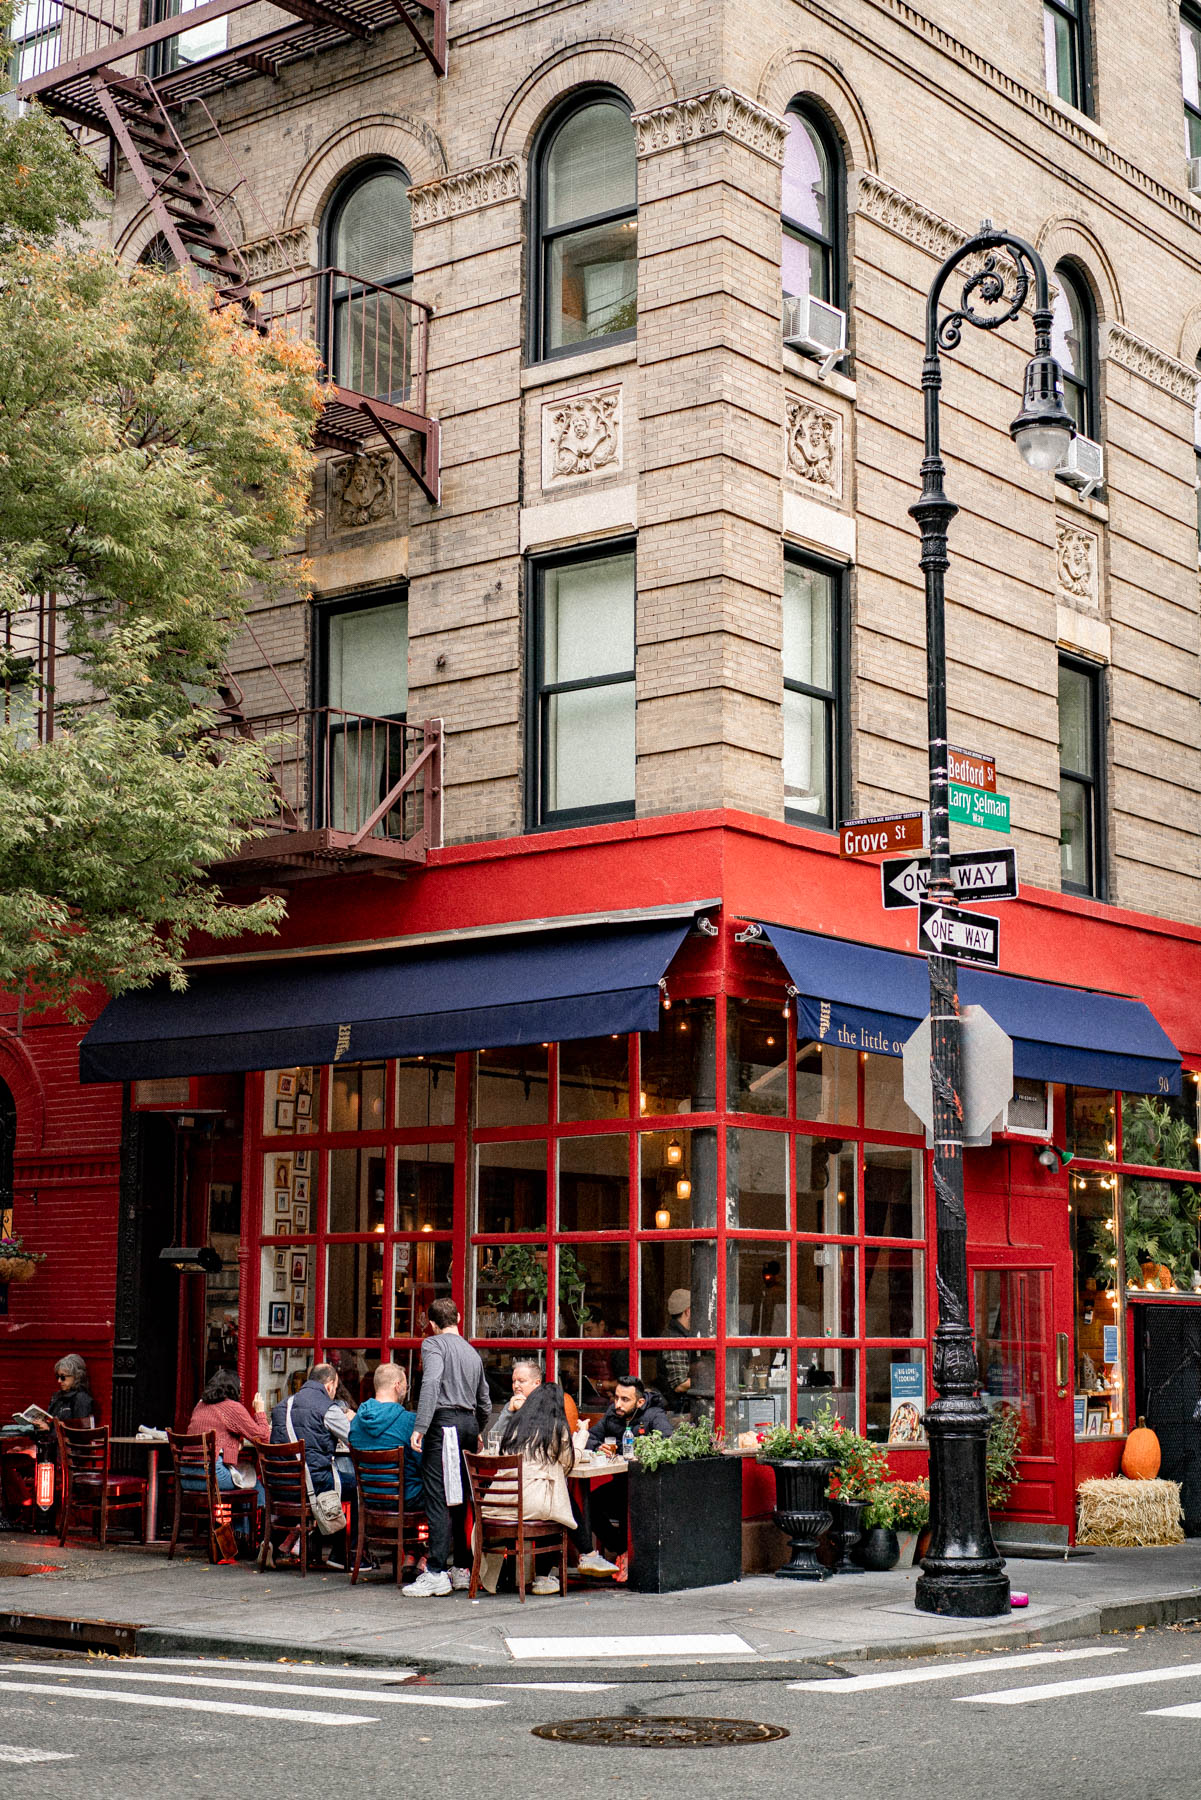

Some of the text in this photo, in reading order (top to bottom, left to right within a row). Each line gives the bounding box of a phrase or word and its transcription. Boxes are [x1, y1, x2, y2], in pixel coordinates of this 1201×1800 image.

[948, 755, 994, 787] Bedford St
[949, 787, 1007, 818] Larry Selman
[972, 812, 985, 826] Way
[844, 825, 906, 855] Grove St
[903, 865, 998, 891] ON WAY
[932, 920, 989, 949] ONE WAY
[837, 1023, 857, 1045] the
[861, 1027, 889, 1051] little
[1157, 1076, 1169, 1093] 90
